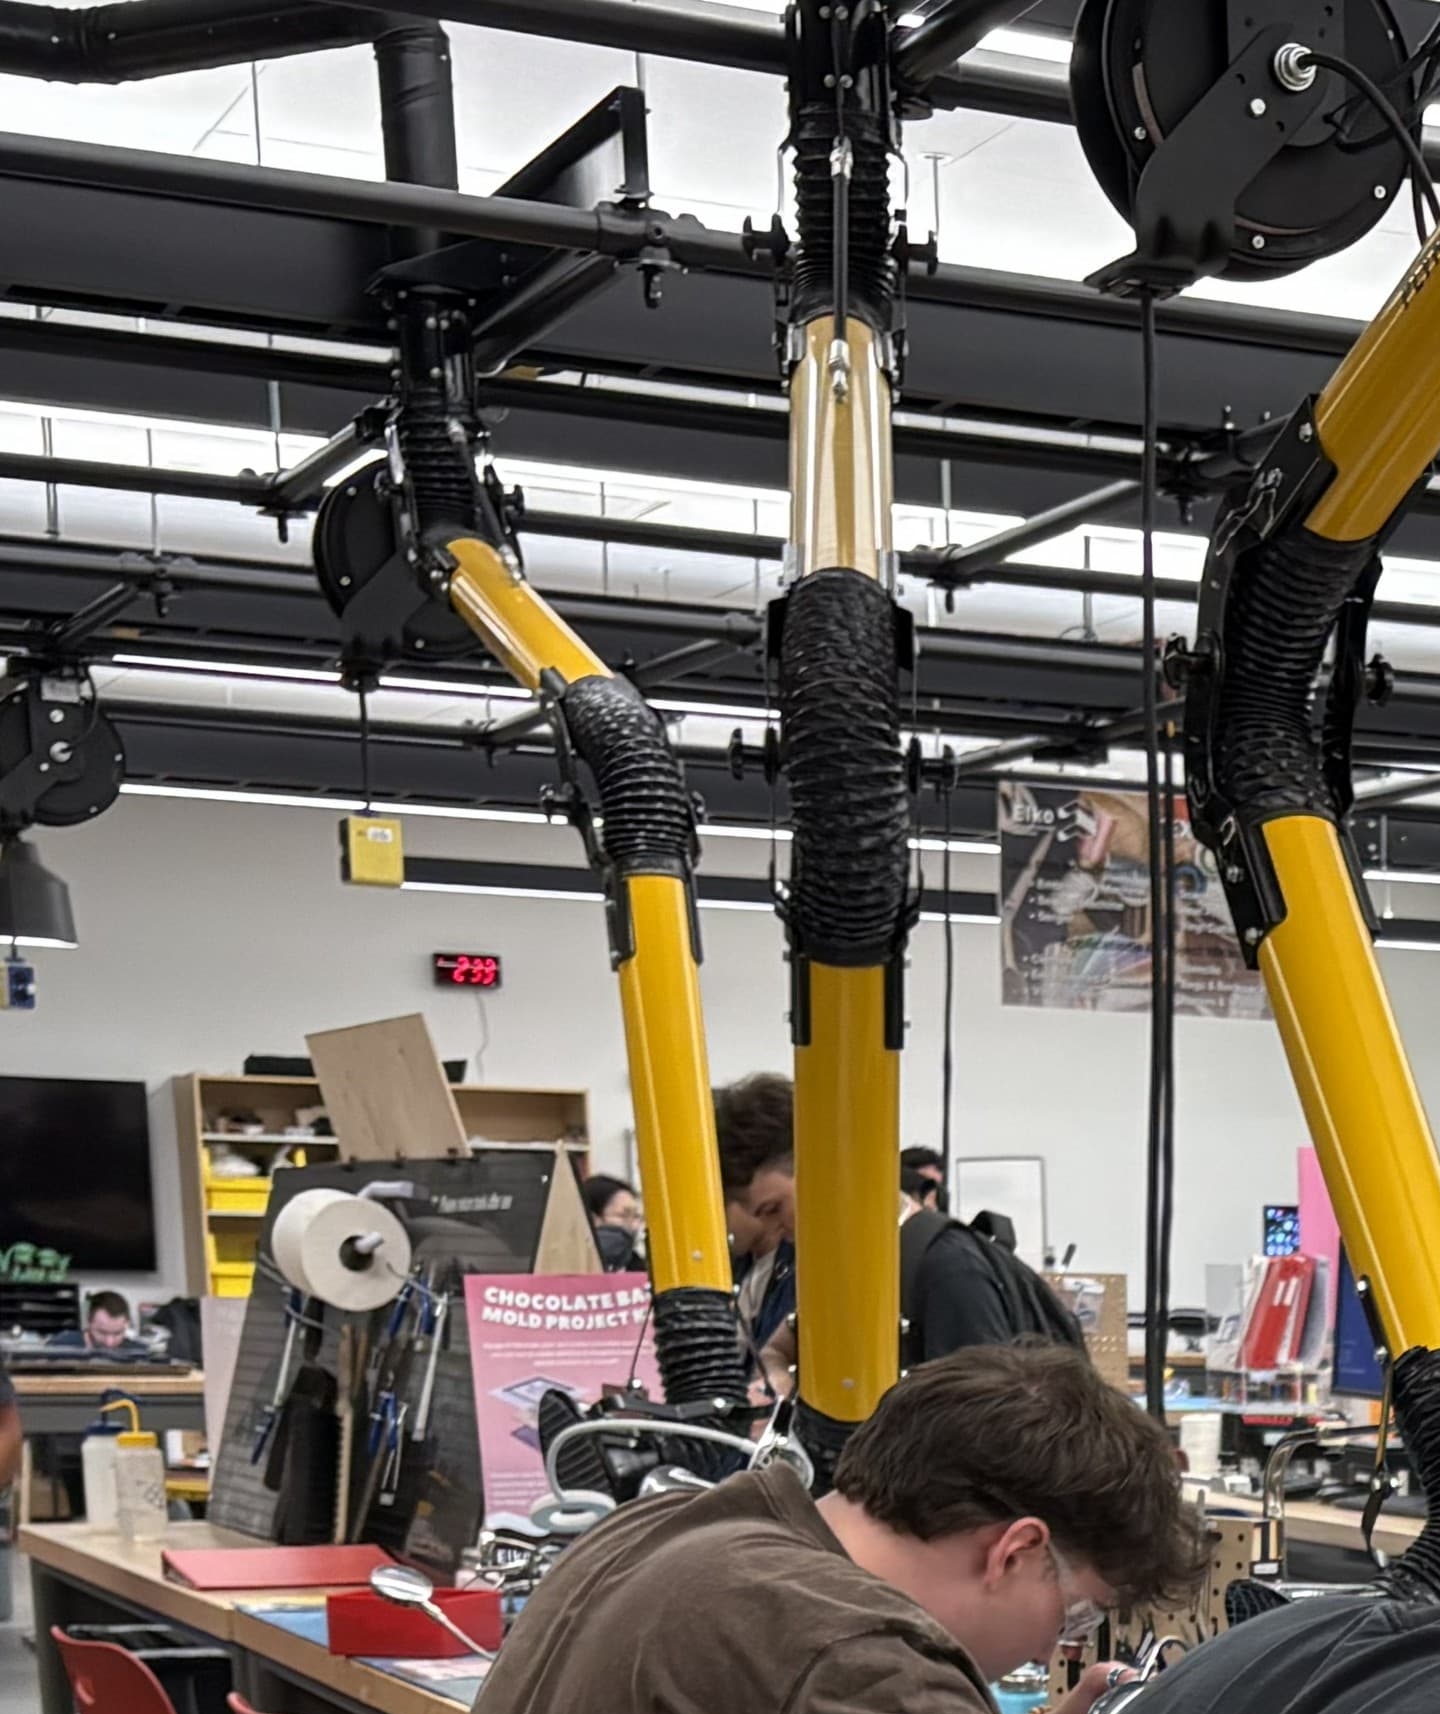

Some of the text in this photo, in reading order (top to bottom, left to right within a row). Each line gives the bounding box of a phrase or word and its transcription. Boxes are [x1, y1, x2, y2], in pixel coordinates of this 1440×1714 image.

[484, 1286, 615, 1312] CHOCOLATE
[481, 1306, 542, 1329] MOLD
[544, 1310, 629, 1330] PROJECT
